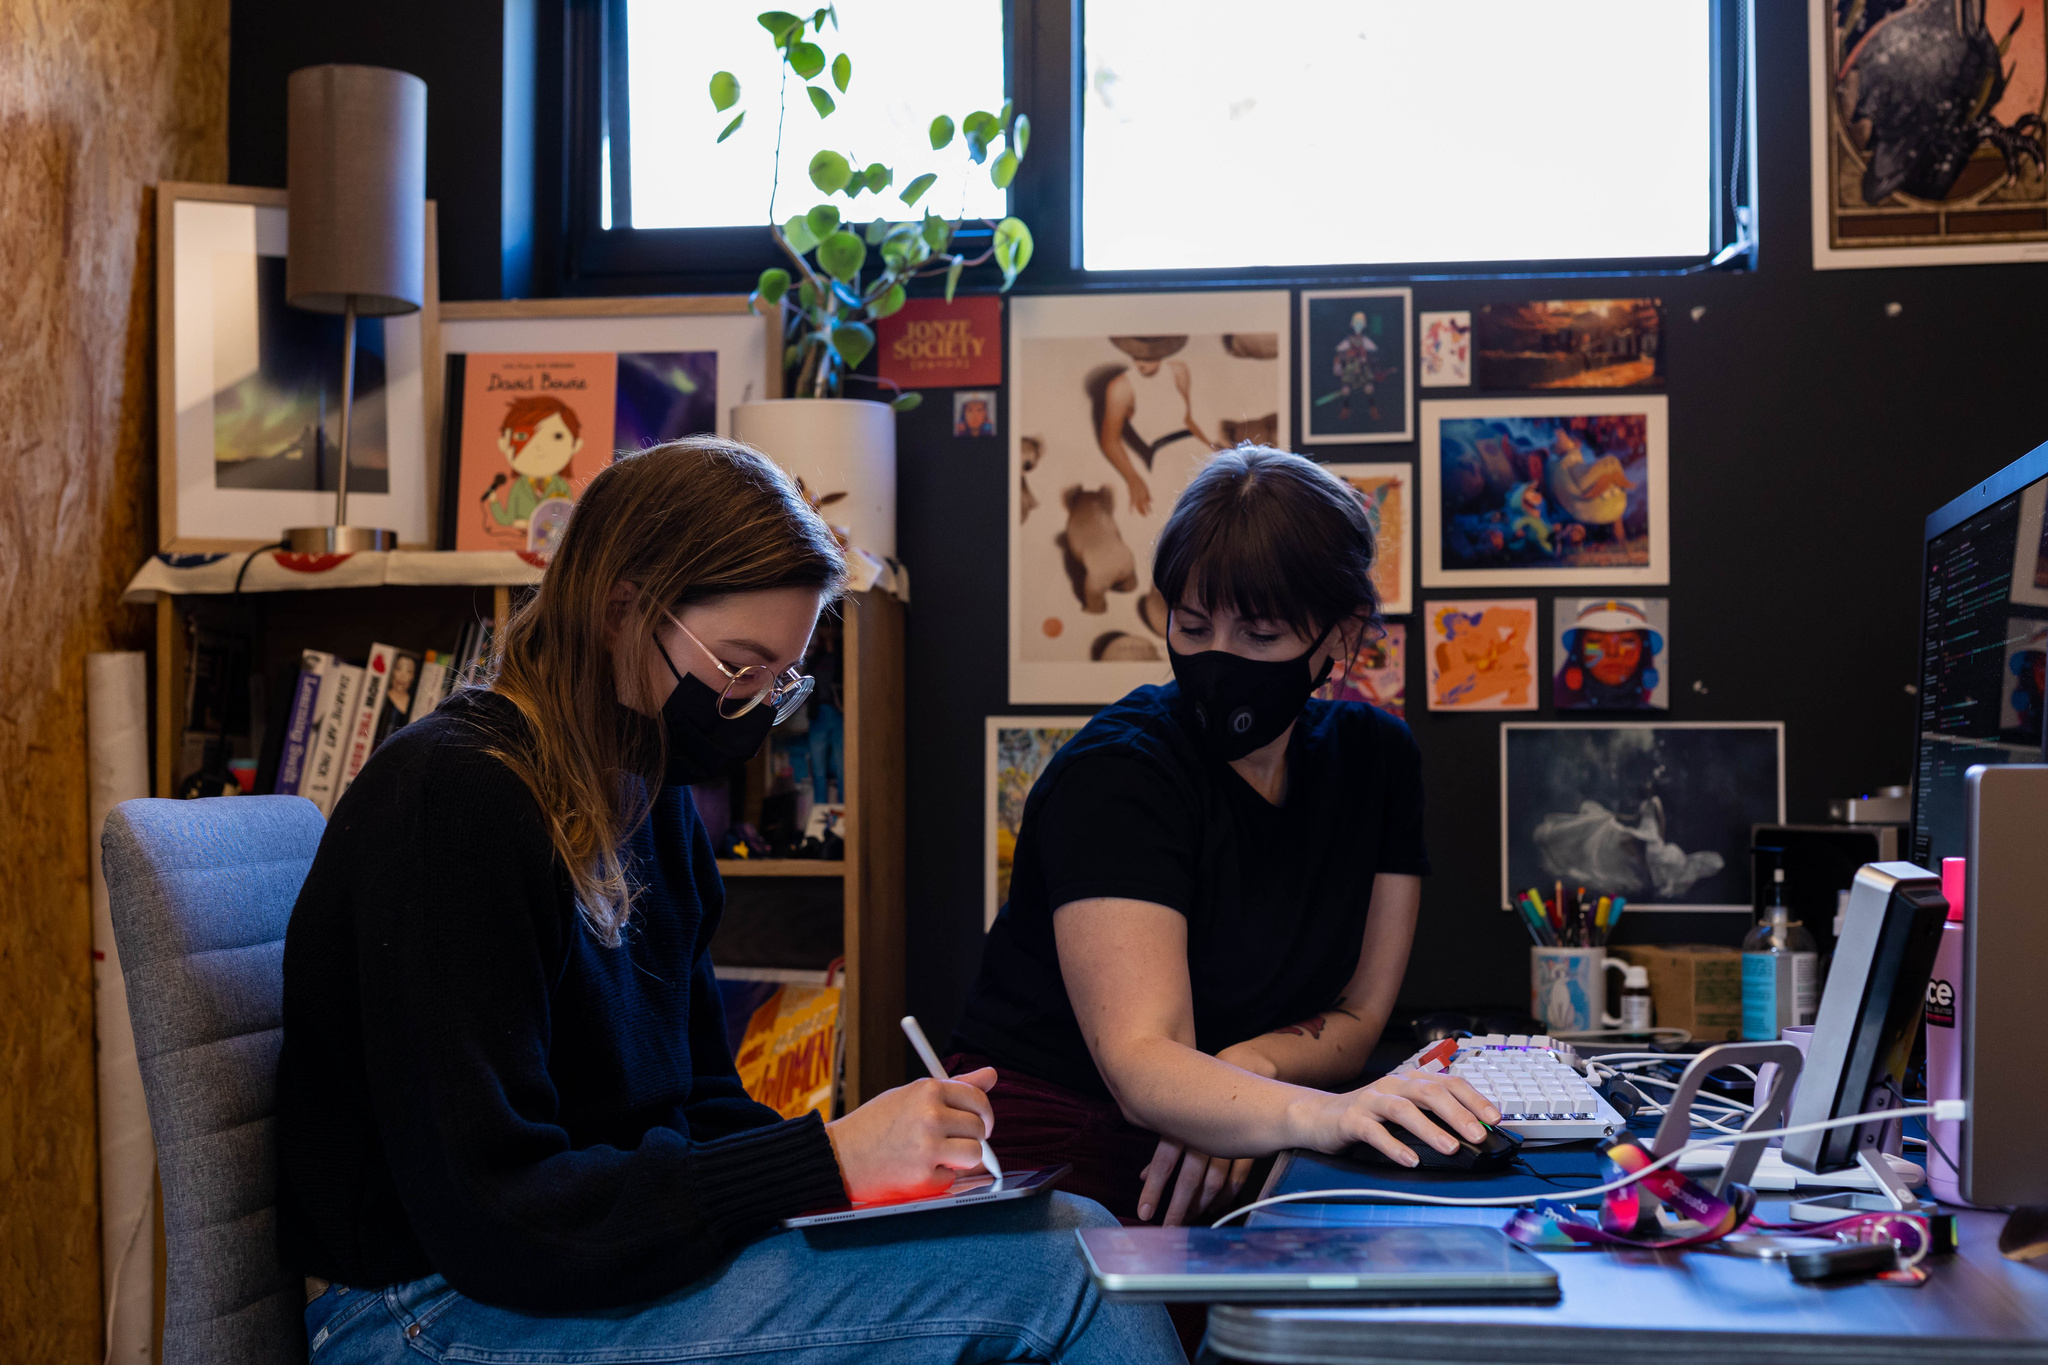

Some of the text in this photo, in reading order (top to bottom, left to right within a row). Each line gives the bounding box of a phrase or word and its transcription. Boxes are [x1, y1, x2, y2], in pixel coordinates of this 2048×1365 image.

[893, 337, 985, 360] SOCIETY
[487, 372, 587, 391] David Bowie
[366, 676, 381, 708] HOW
[282, 676, 318, 785] Learning Swift
[1926, 981, 1953, 1006] ce
[1662, 1178, 1709, 1214] Procreate
